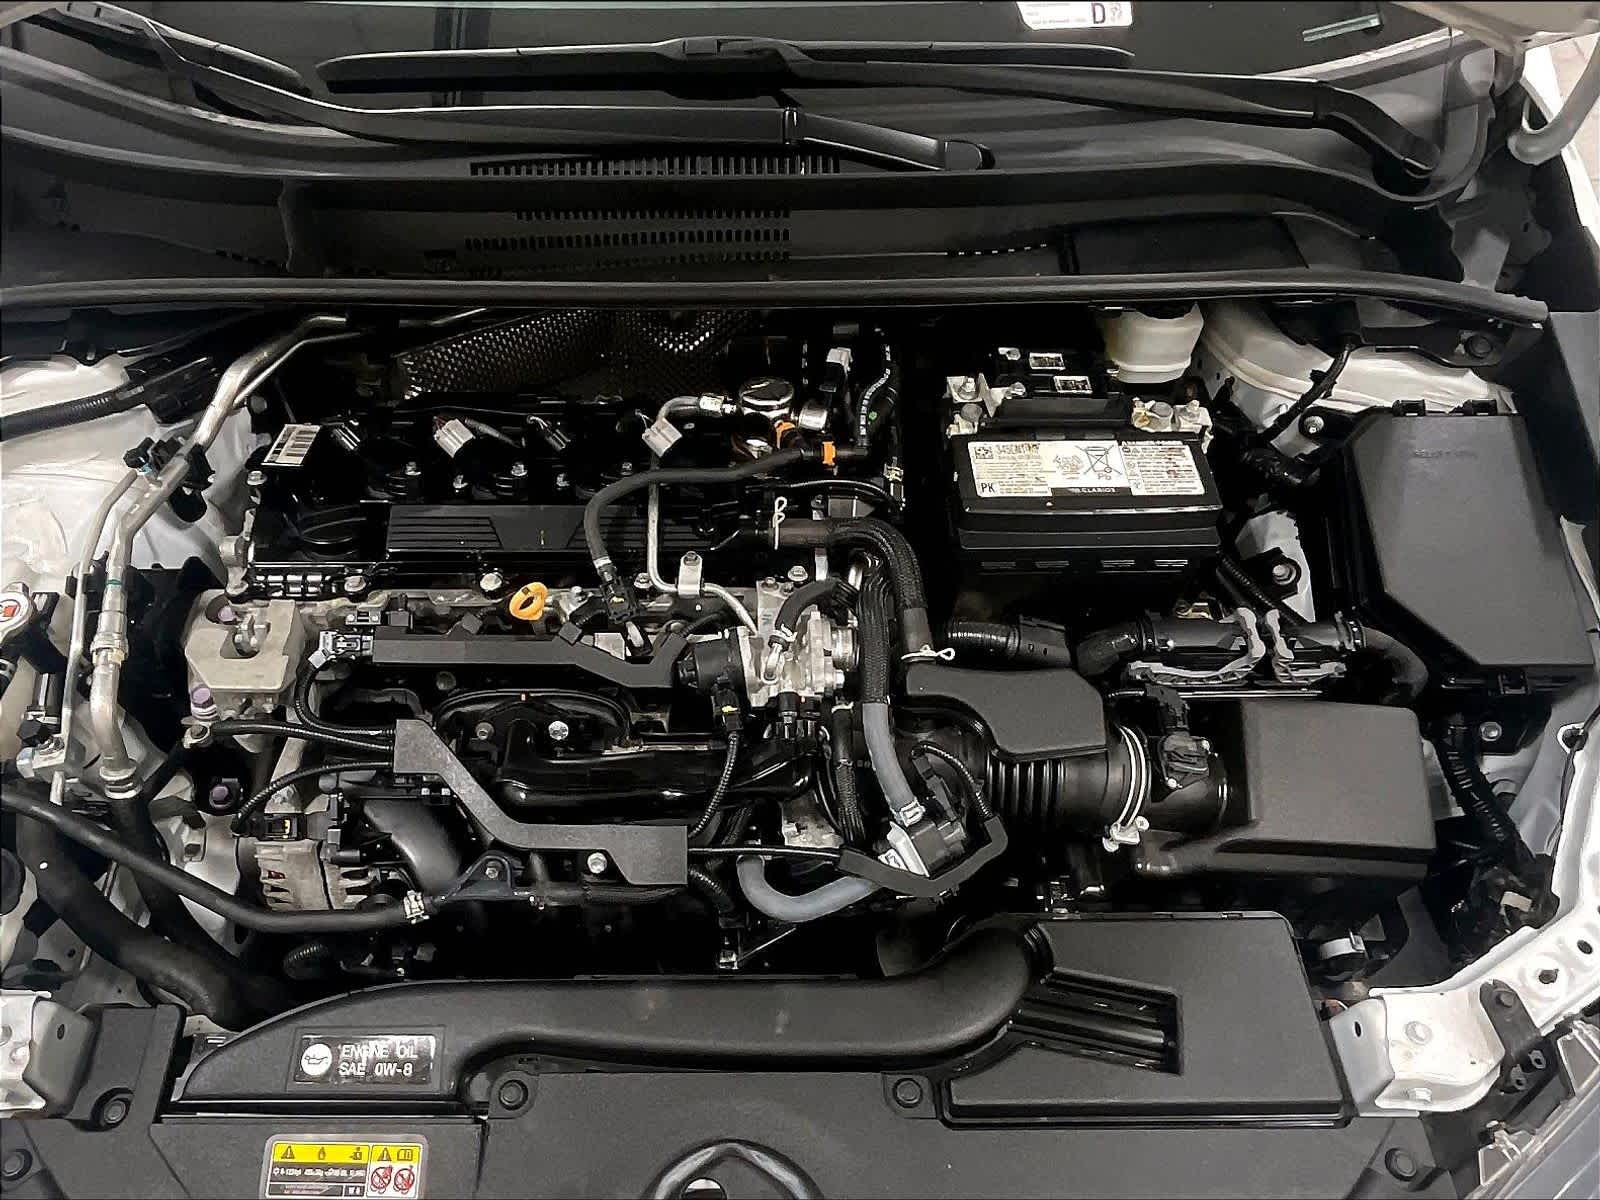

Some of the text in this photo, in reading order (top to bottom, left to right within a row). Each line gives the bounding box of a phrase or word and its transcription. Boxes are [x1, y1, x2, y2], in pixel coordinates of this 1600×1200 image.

[1092, 2, 1106, 24] D
[981, 482, 995, 492] PK
[396, 1043, 418, 1058] OIL
[338, 1061, 413, 1076] SAE 0W-8
